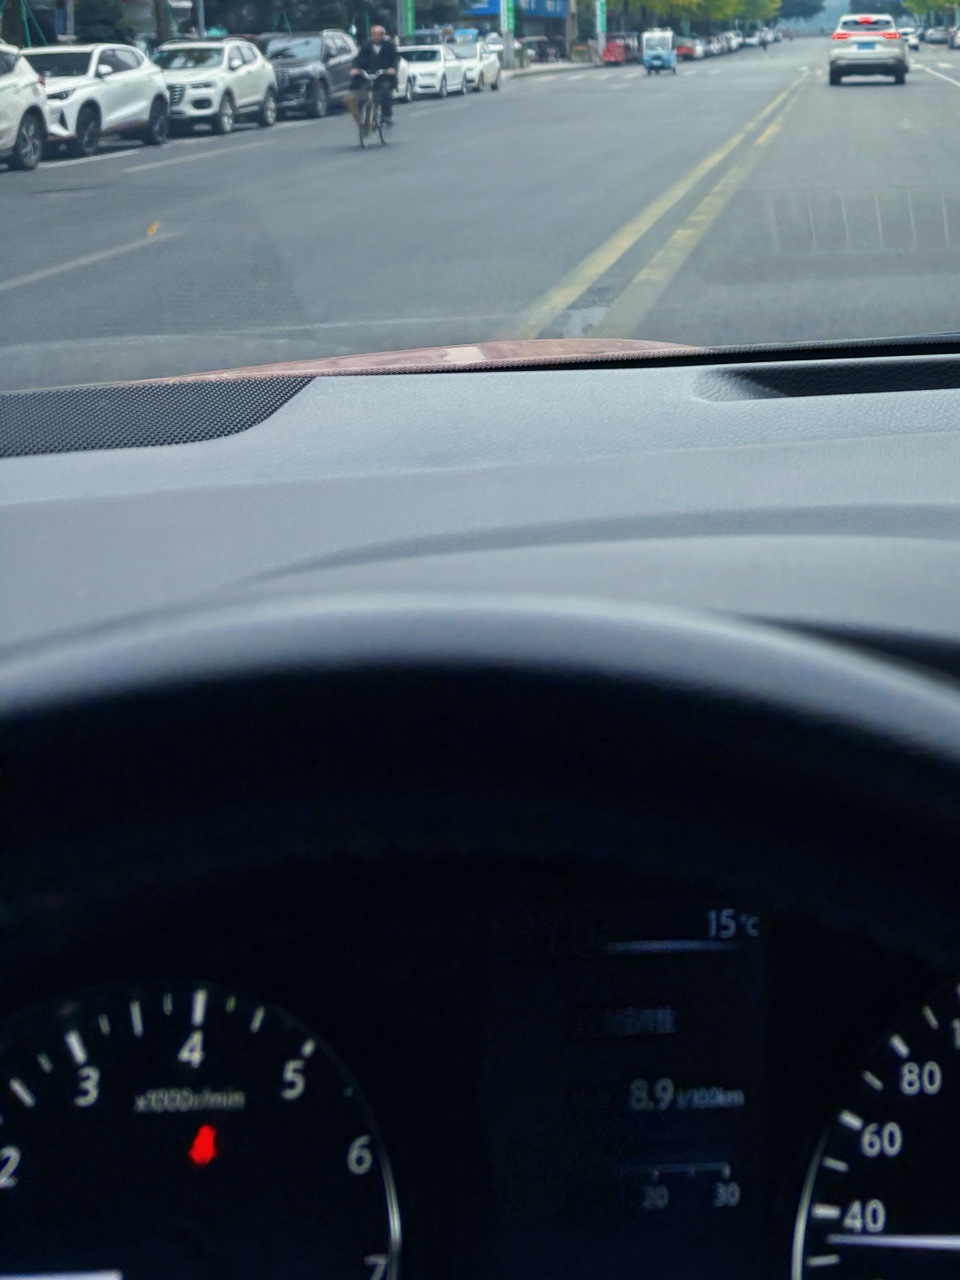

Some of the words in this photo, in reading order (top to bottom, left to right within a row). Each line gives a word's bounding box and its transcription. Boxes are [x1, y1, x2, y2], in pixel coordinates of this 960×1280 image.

[177, 1028, 205, 1069] 4
[73, 1065, 101, 1108] 3
[280, 1058, 306, 1101] 5
[628, 1077, 675, 1111] 8.9
[900, 1061, 943, 1096] 80
[346, 1133, 374, 1176] 6
[860, 1121, 903, 1158] 60
[0, 1145, 21, 1189] 2
[842, 1198, 886, 1234] 40
